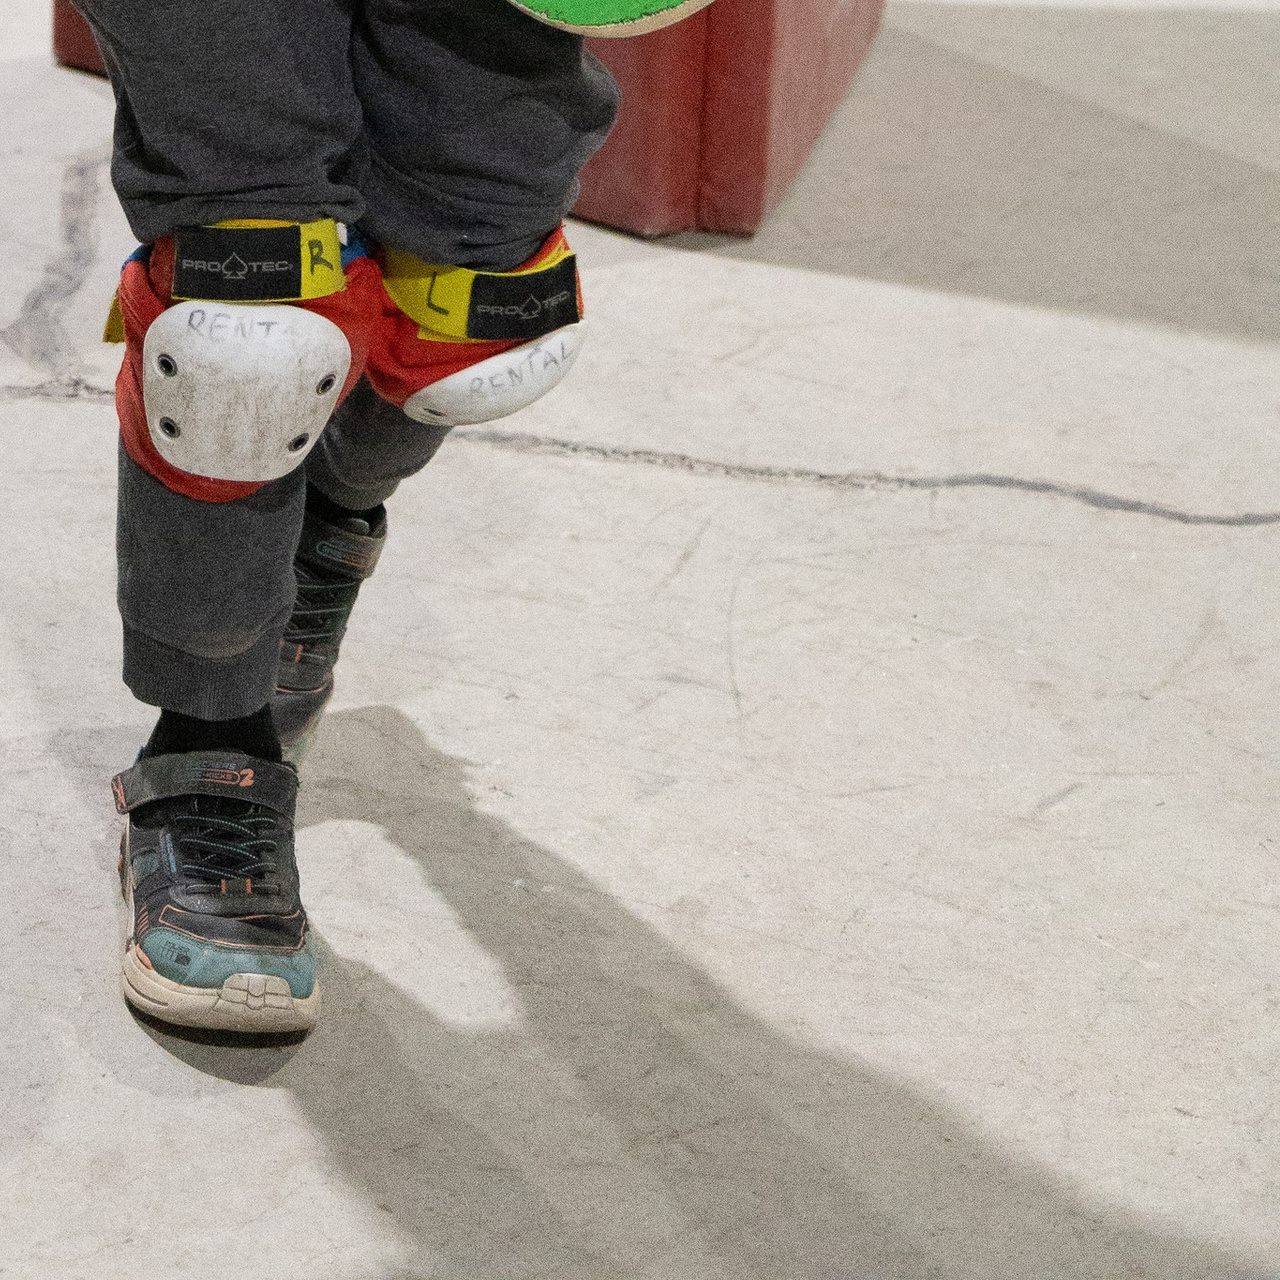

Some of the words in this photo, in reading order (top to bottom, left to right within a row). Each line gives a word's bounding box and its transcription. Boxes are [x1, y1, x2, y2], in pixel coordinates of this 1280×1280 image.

[182, 259, 220, 272] PRO
[248, 261, 289, 272] TEC
[308, 239, 334, 275] R
[427, 272, 449, 316] L
